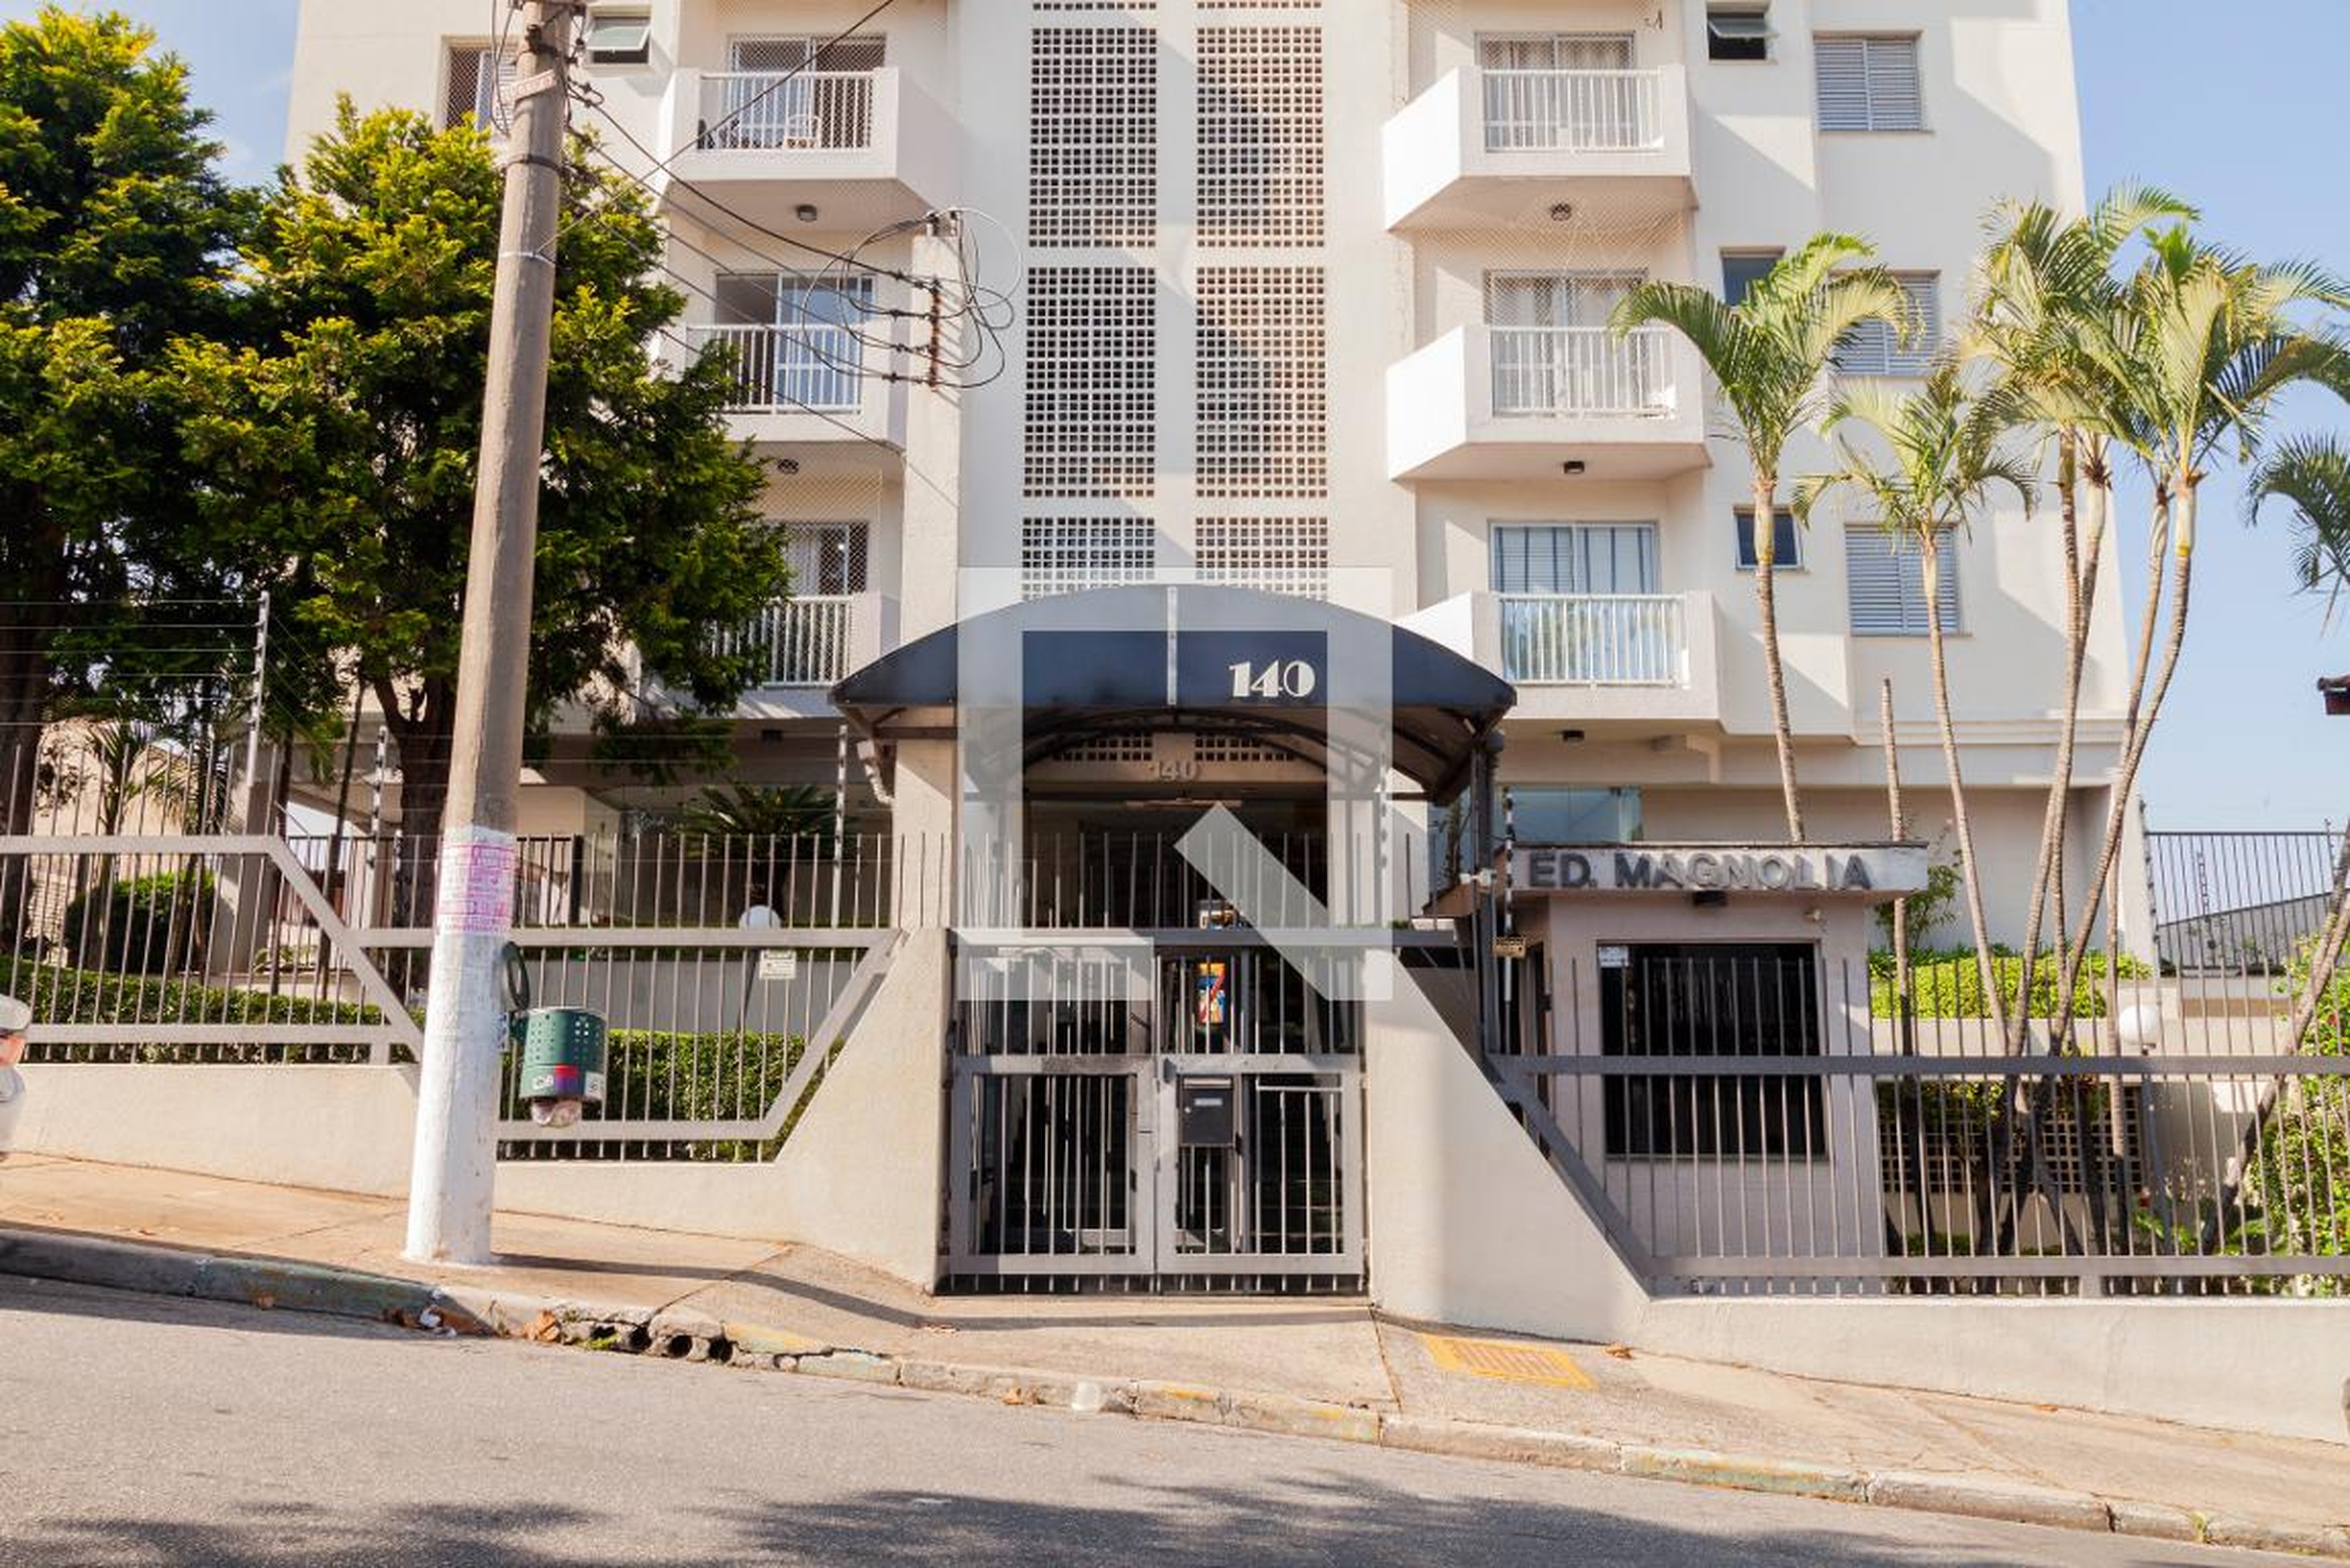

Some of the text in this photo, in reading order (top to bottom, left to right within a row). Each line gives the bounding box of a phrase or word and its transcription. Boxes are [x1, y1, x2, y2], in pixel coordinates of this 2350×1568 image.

[1229, 659, 1315, 697] 140
[1149, 760, 1198, 782] 140
[1529, 853, 1873, 889] ED. MAGNOLIA
